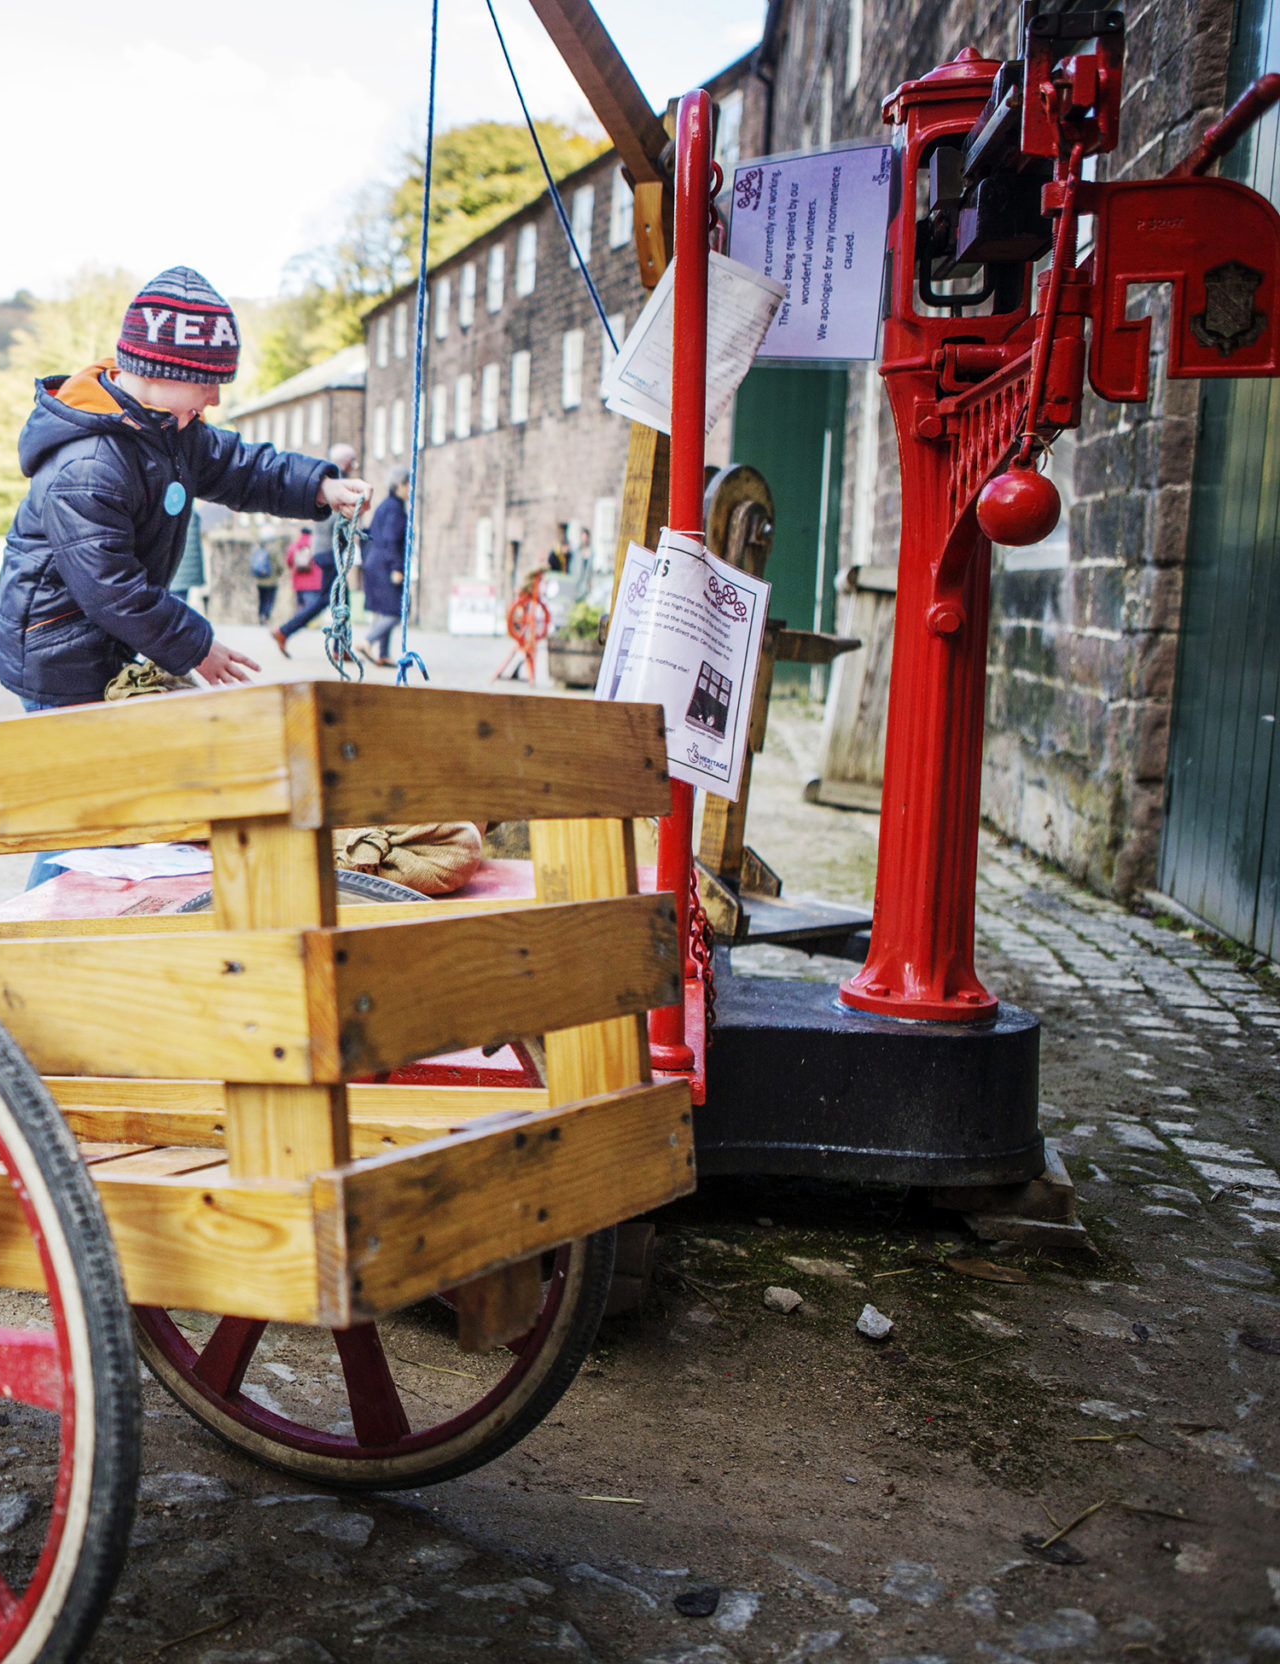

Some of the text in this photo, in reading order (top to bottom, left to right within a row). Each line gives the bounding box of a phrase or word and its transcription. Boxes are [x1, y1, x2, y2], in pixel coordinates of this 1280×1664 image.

[790, 182, 799, 197] our
[768, 205, 776, 220] not
[787, 199, 799, 210] by
[785, 211, 797, 250] repaired
[765, 222, 777, 264] currently
[844, 231, 855, 270] caused.
[801, 198, 817, 306] wonderful volunteers.
[817, 166, 842, 341] We apologise for any inconvenience
[764, 265, 773, 277] re
[782, 253, 796, 280] being
[779, 301, 792, 327] They
[141, 307, 238, 347] YEA
[665, 591, 686, 602] around
[686, 597, 694, 605] the
[671, 602, 683, 611] high
[663, 624, 674, 632] and
[675, 627, 690, 638] direct
[681, 619, 697, 629] handle
[656, 658, 677, 670] nothing
[699, 754, 728, 771] HERITAGE
